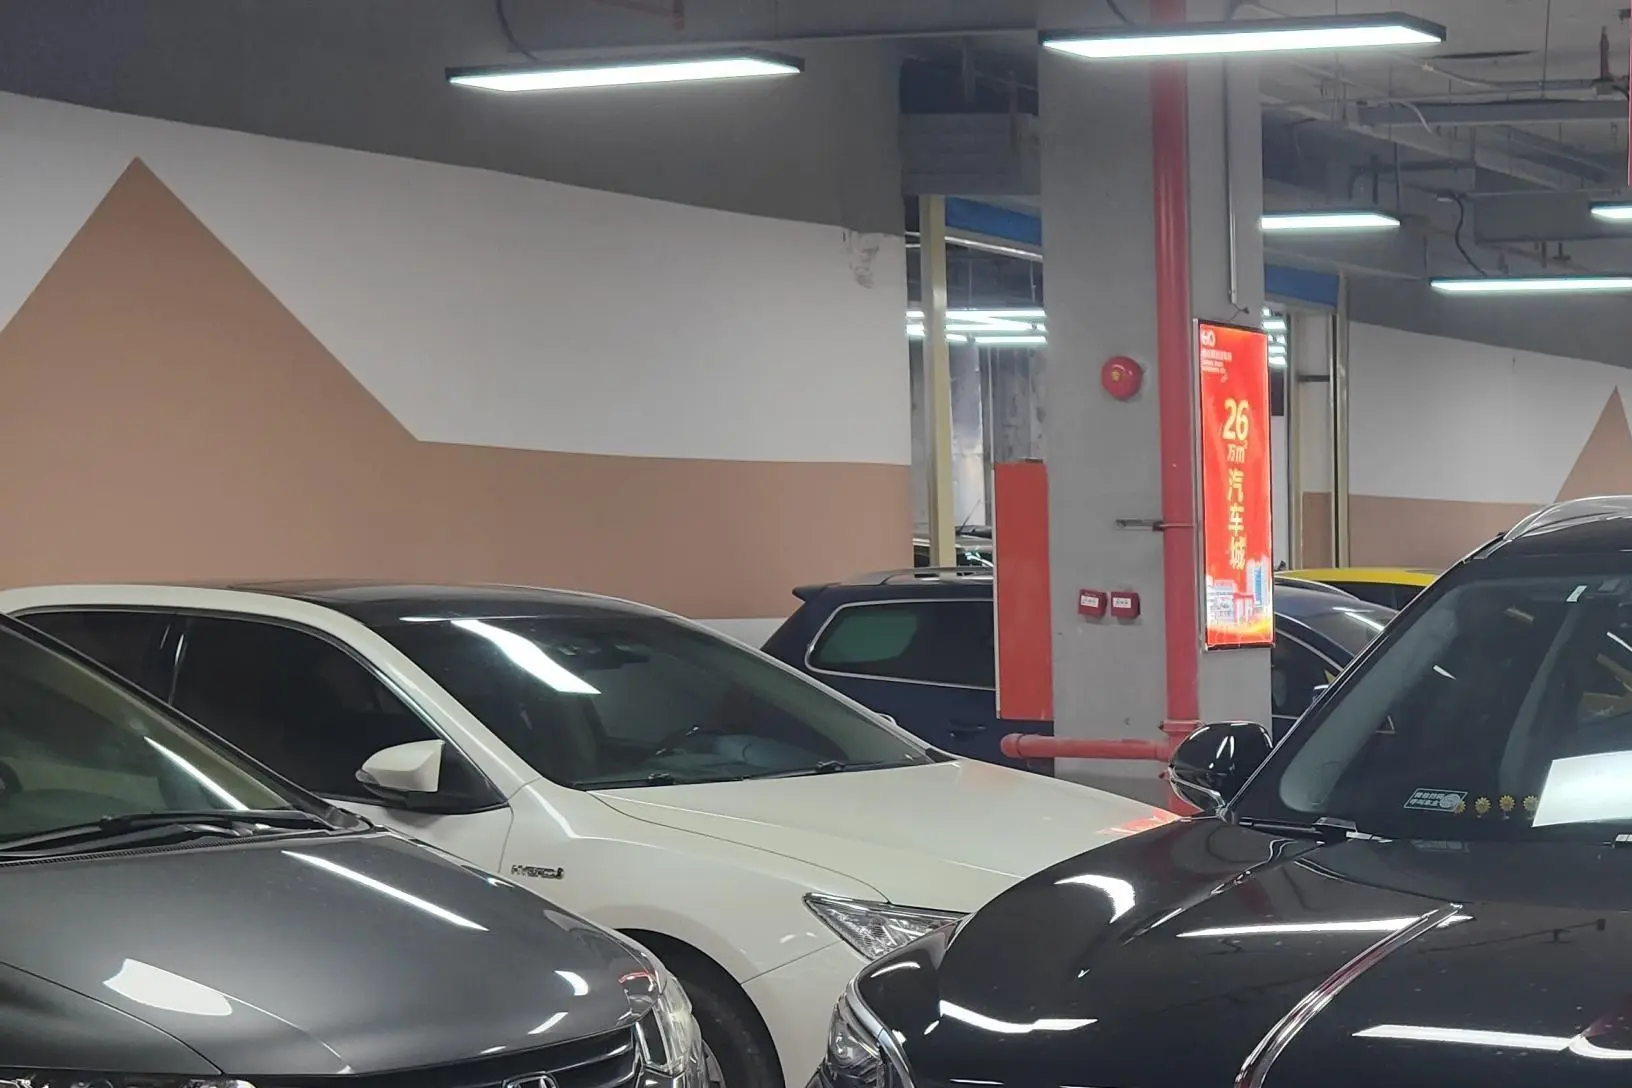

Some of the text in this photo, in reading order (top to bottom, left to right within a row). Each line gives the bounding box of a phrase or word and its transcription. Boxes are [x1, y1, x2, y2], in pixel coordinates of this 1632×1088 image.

[1222, 398, 1250, 441] 26
[1227, 468, 1247, 570] 汽车城
